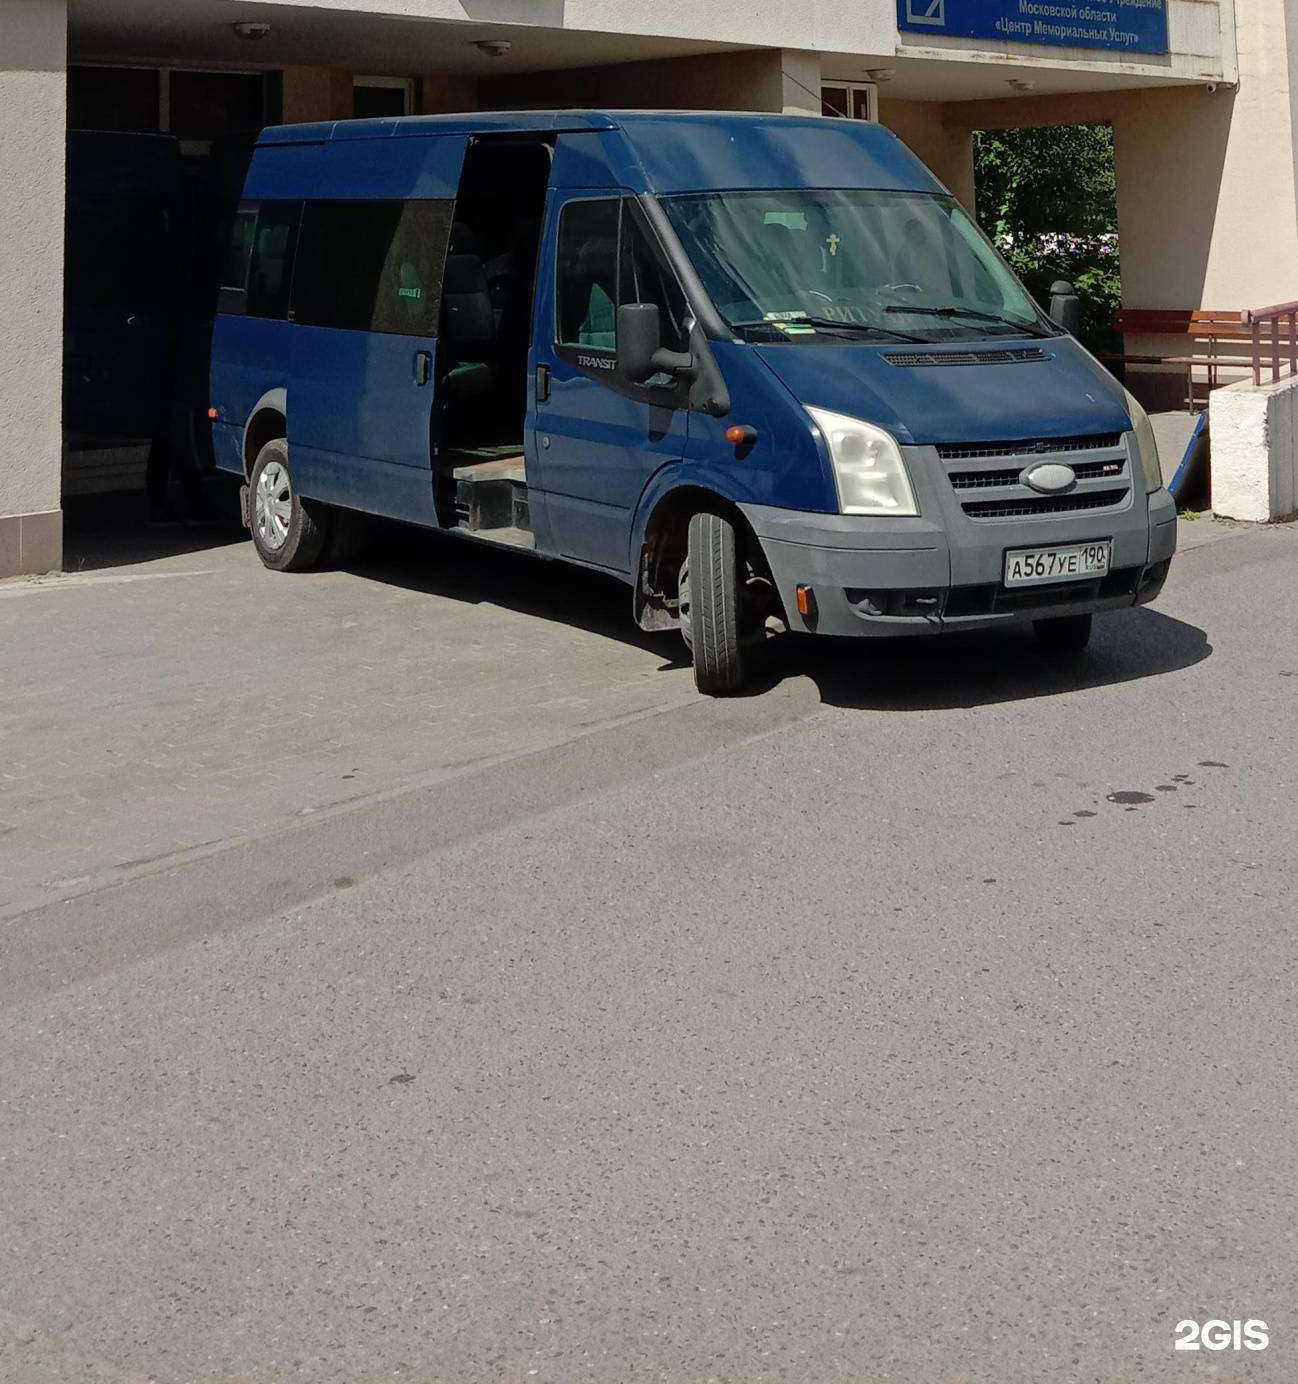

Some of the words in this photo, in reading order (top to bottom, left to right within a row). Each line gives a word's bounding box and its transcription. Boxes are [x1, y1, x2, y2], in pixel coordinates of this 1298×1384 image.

[1018, 0, 1077, 19] Московской
[1079, 9, 1117, 23] области
[1033, 20, 1108, 41] Мемориальных
[1109, 27, 1139, 46] Услуг»
[577, 355, 617, 370] TRANSIT
[1081, 546, 1104, 566] 190
